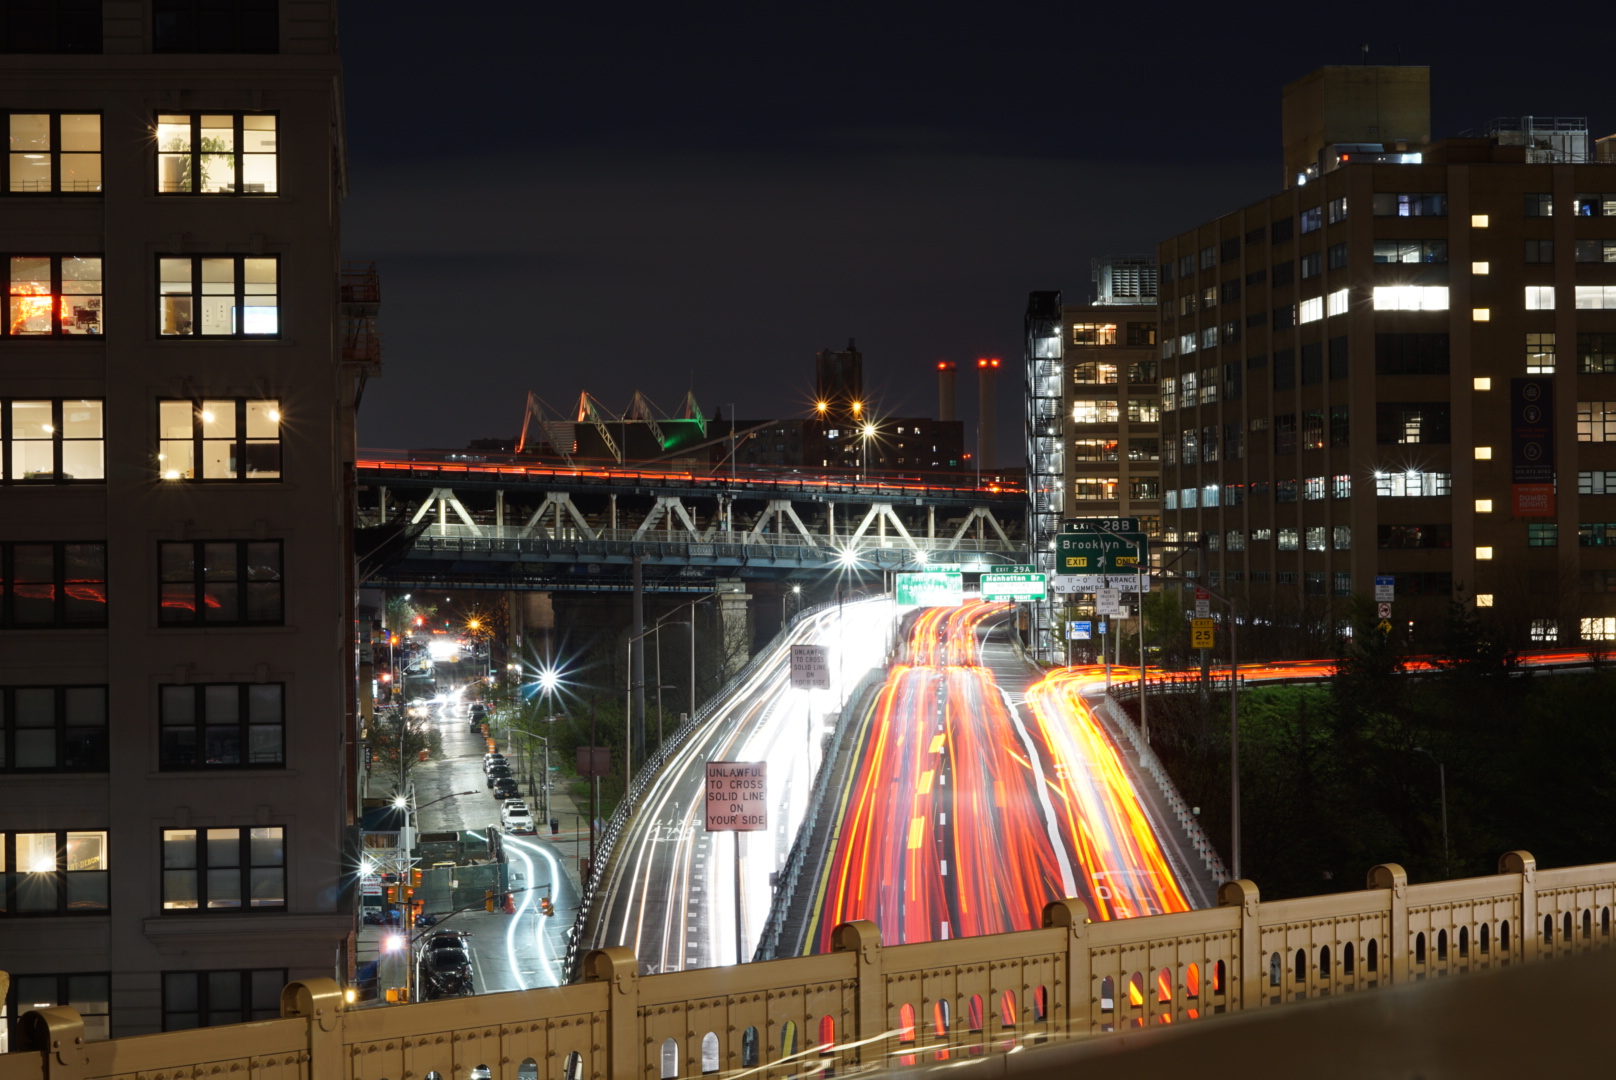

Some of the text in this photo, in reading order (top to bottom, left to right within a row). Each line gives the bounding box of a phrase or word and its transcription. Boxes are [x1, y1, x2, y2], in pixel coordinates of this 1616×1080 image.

[1103, 520, 1130, 530] 28B
[1063, 540, 1119, 552] Brooklyn
[1196, 630, 1210, 640] 25
[709, 768, 764, 778] UNLAWFUL
[710, 780, 764, 789] TO CROSS
[708, 792, 765, 801] SOLID LINE
[730, 804, 744, 812] ON
[710, 816, 764, 824] YOUR SIDE
